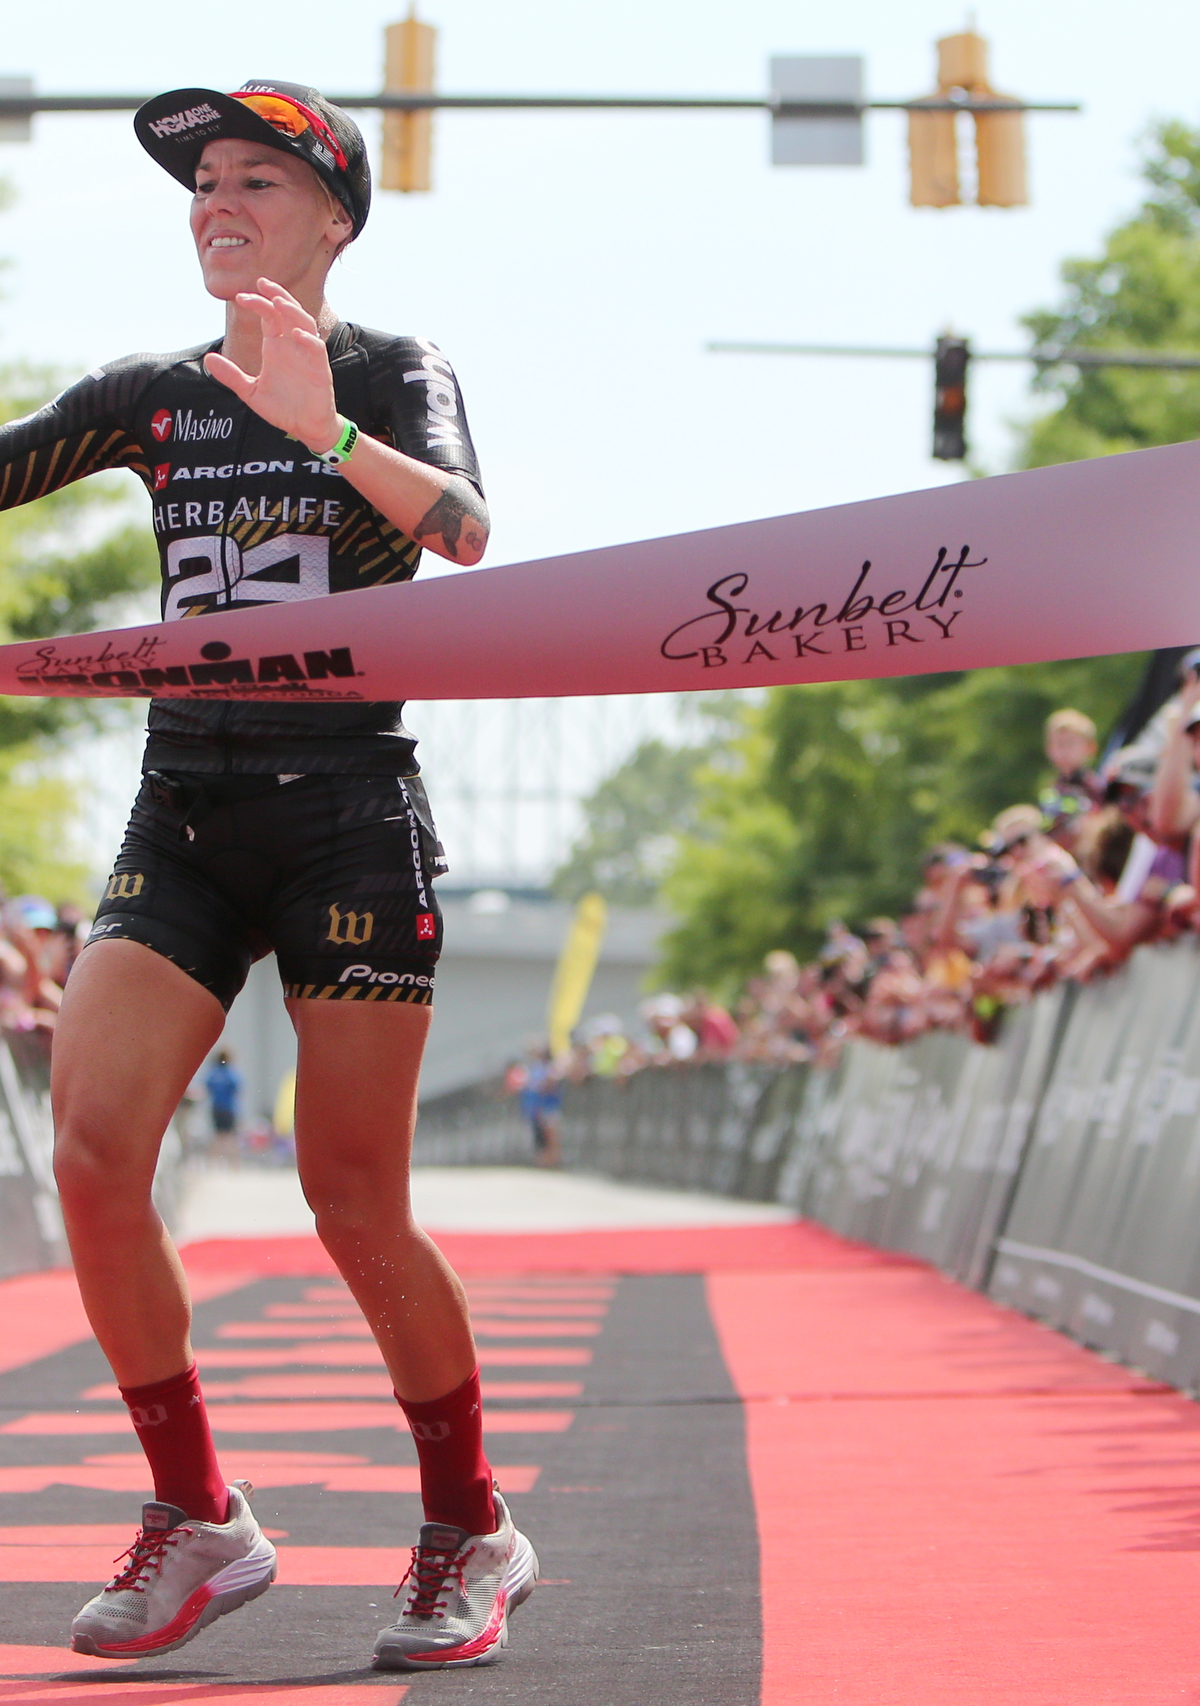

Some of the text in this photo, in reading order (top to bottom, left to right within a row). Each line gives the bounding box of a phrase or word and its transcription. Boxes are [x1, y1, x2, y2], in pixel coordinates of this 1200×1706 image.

[148, 103, 212, 138] HOKA ONE
[200, 109, 221, 123] ONE
[403, 336, 462, 449] waho
[154, 496, 341, 533] HERBALIFE
[700, 610, 963, 669] BAKERY
[338, 964, 436, 988] Pionee
